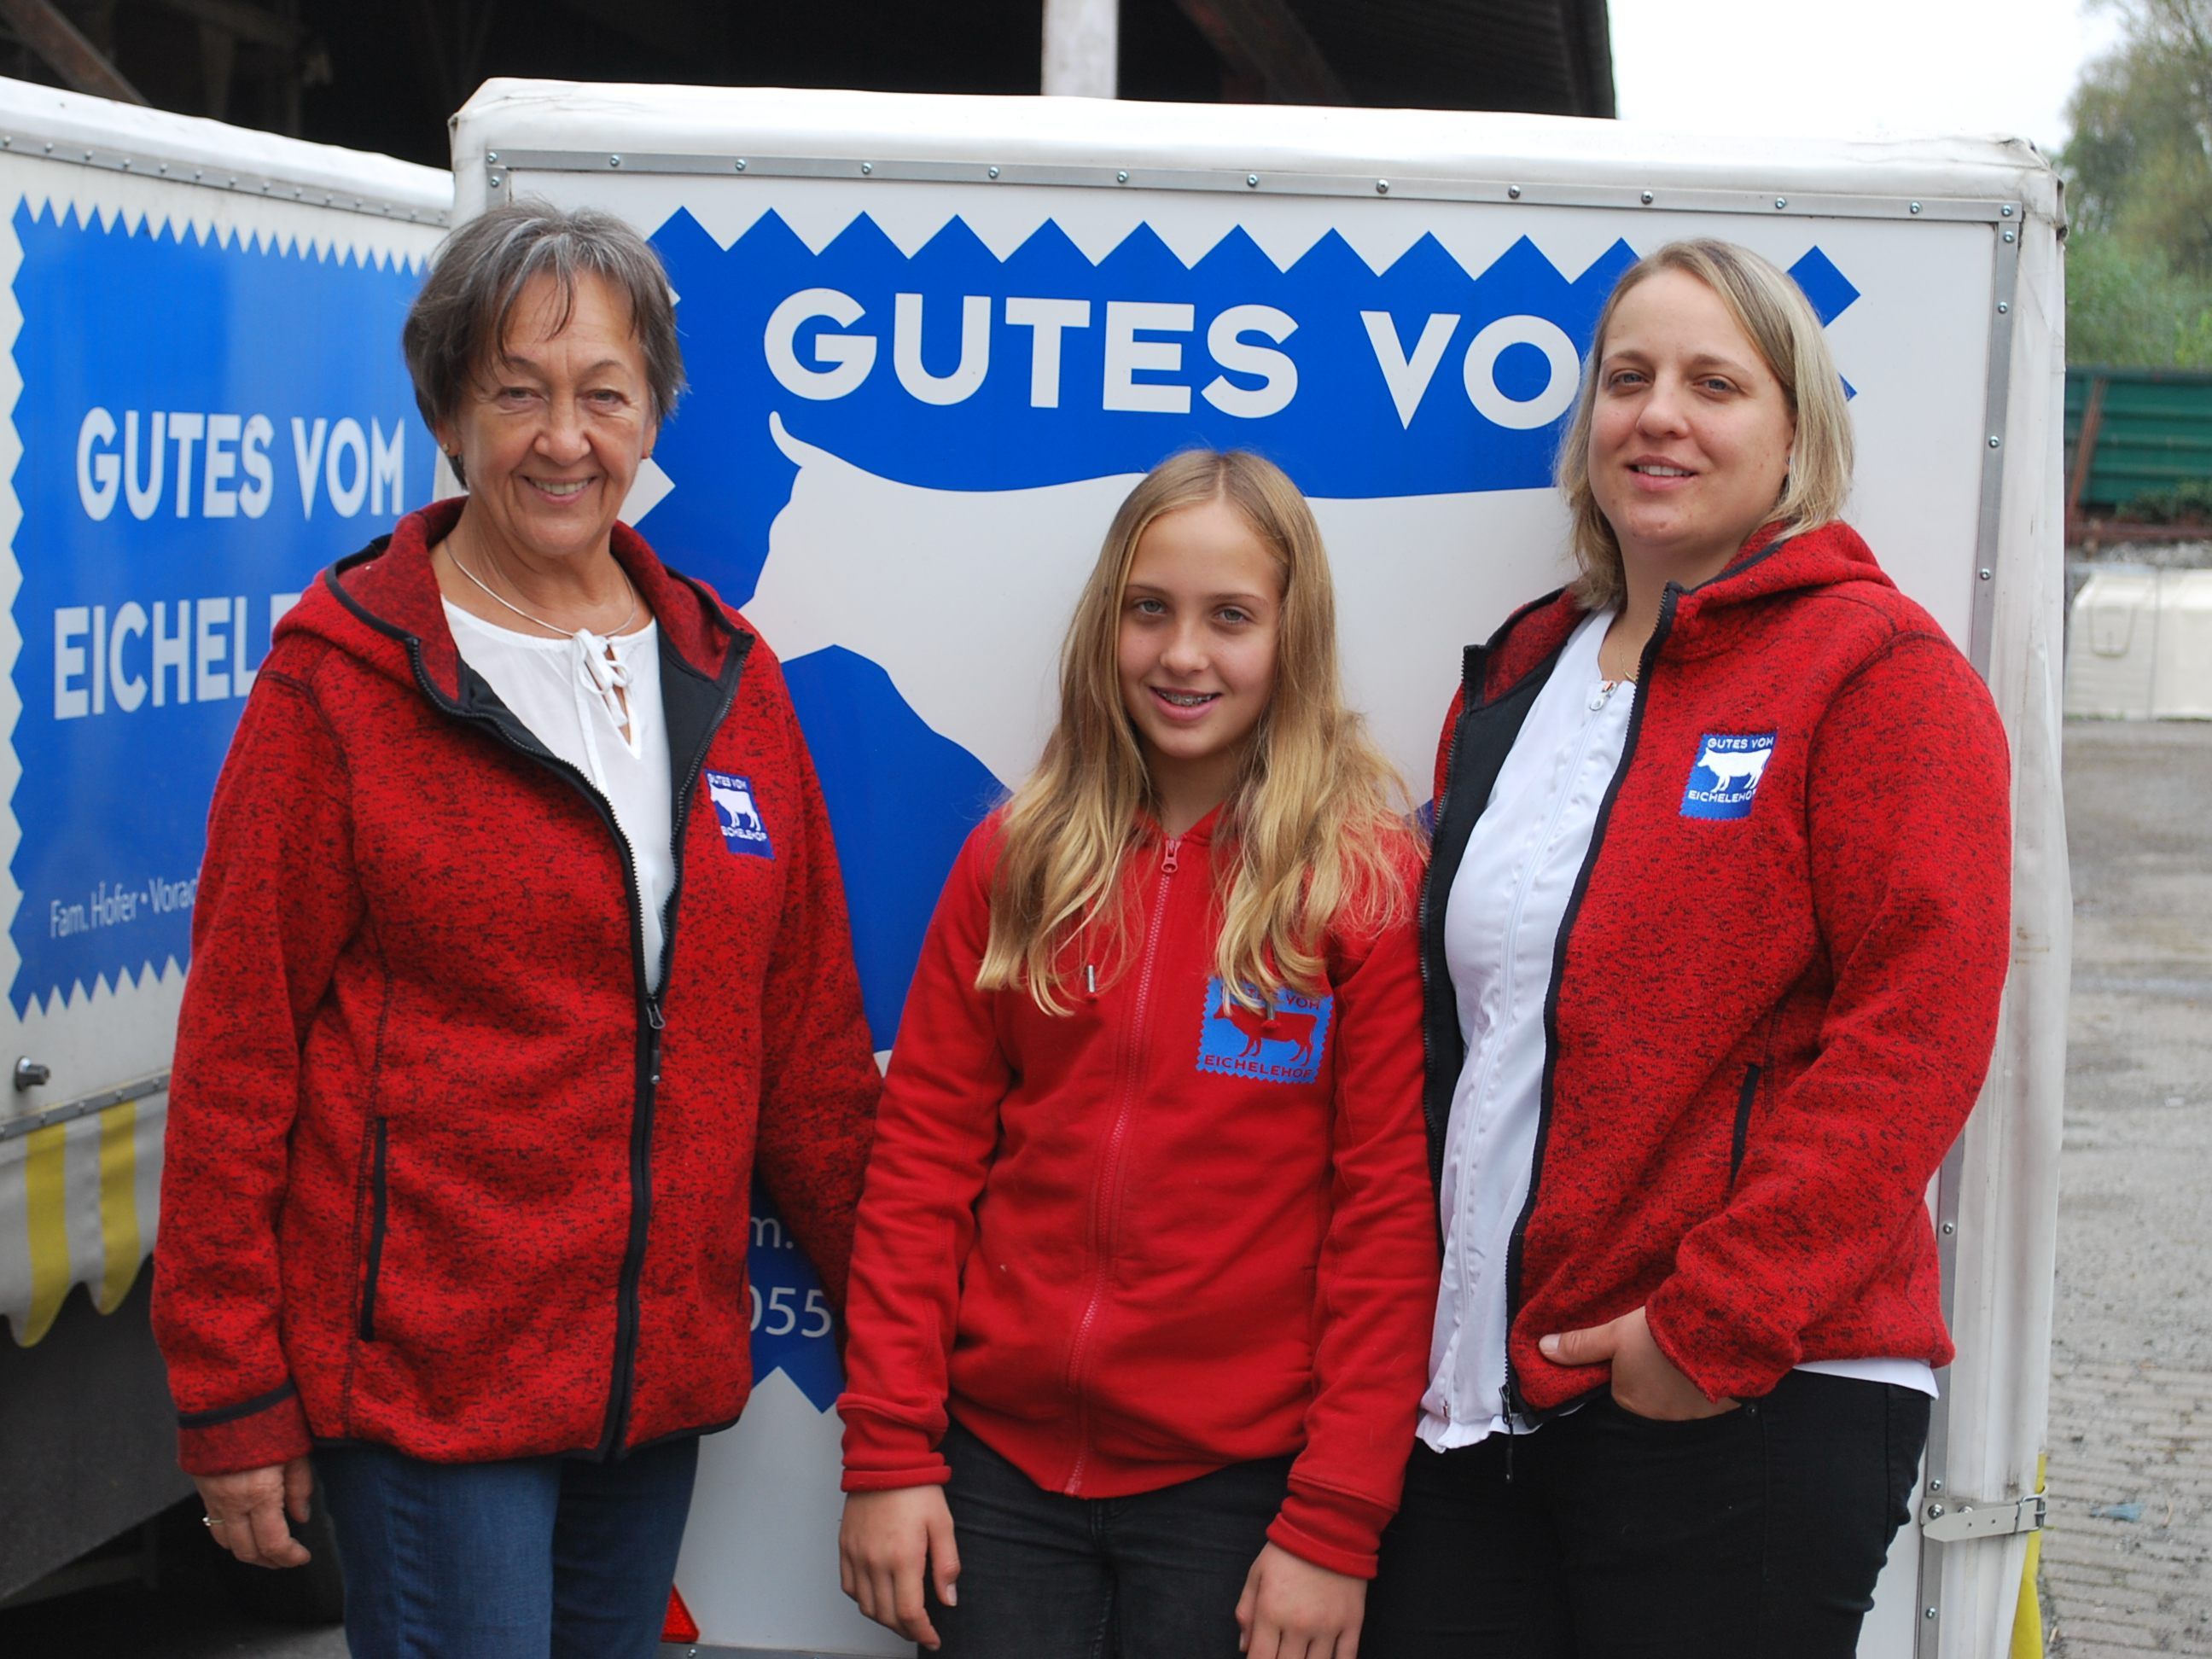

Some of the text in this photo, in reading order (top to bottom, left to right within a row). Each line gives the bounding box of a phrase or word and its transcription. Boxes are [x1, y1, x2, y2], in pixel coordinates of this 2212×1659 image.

[764, 288, 1580, 430] GUTES VO
[76, 405, 405, 522] GUTES VOM
[55, 592, 301, 720] EICHEL
[1708, 736, 1774, 749] GUTES VOM
[50, 899, 89, 939] Fam.
[90, 880, 139, 928] Hofer
[1204, 1054, 1313, 1079] EICHELEHOF
